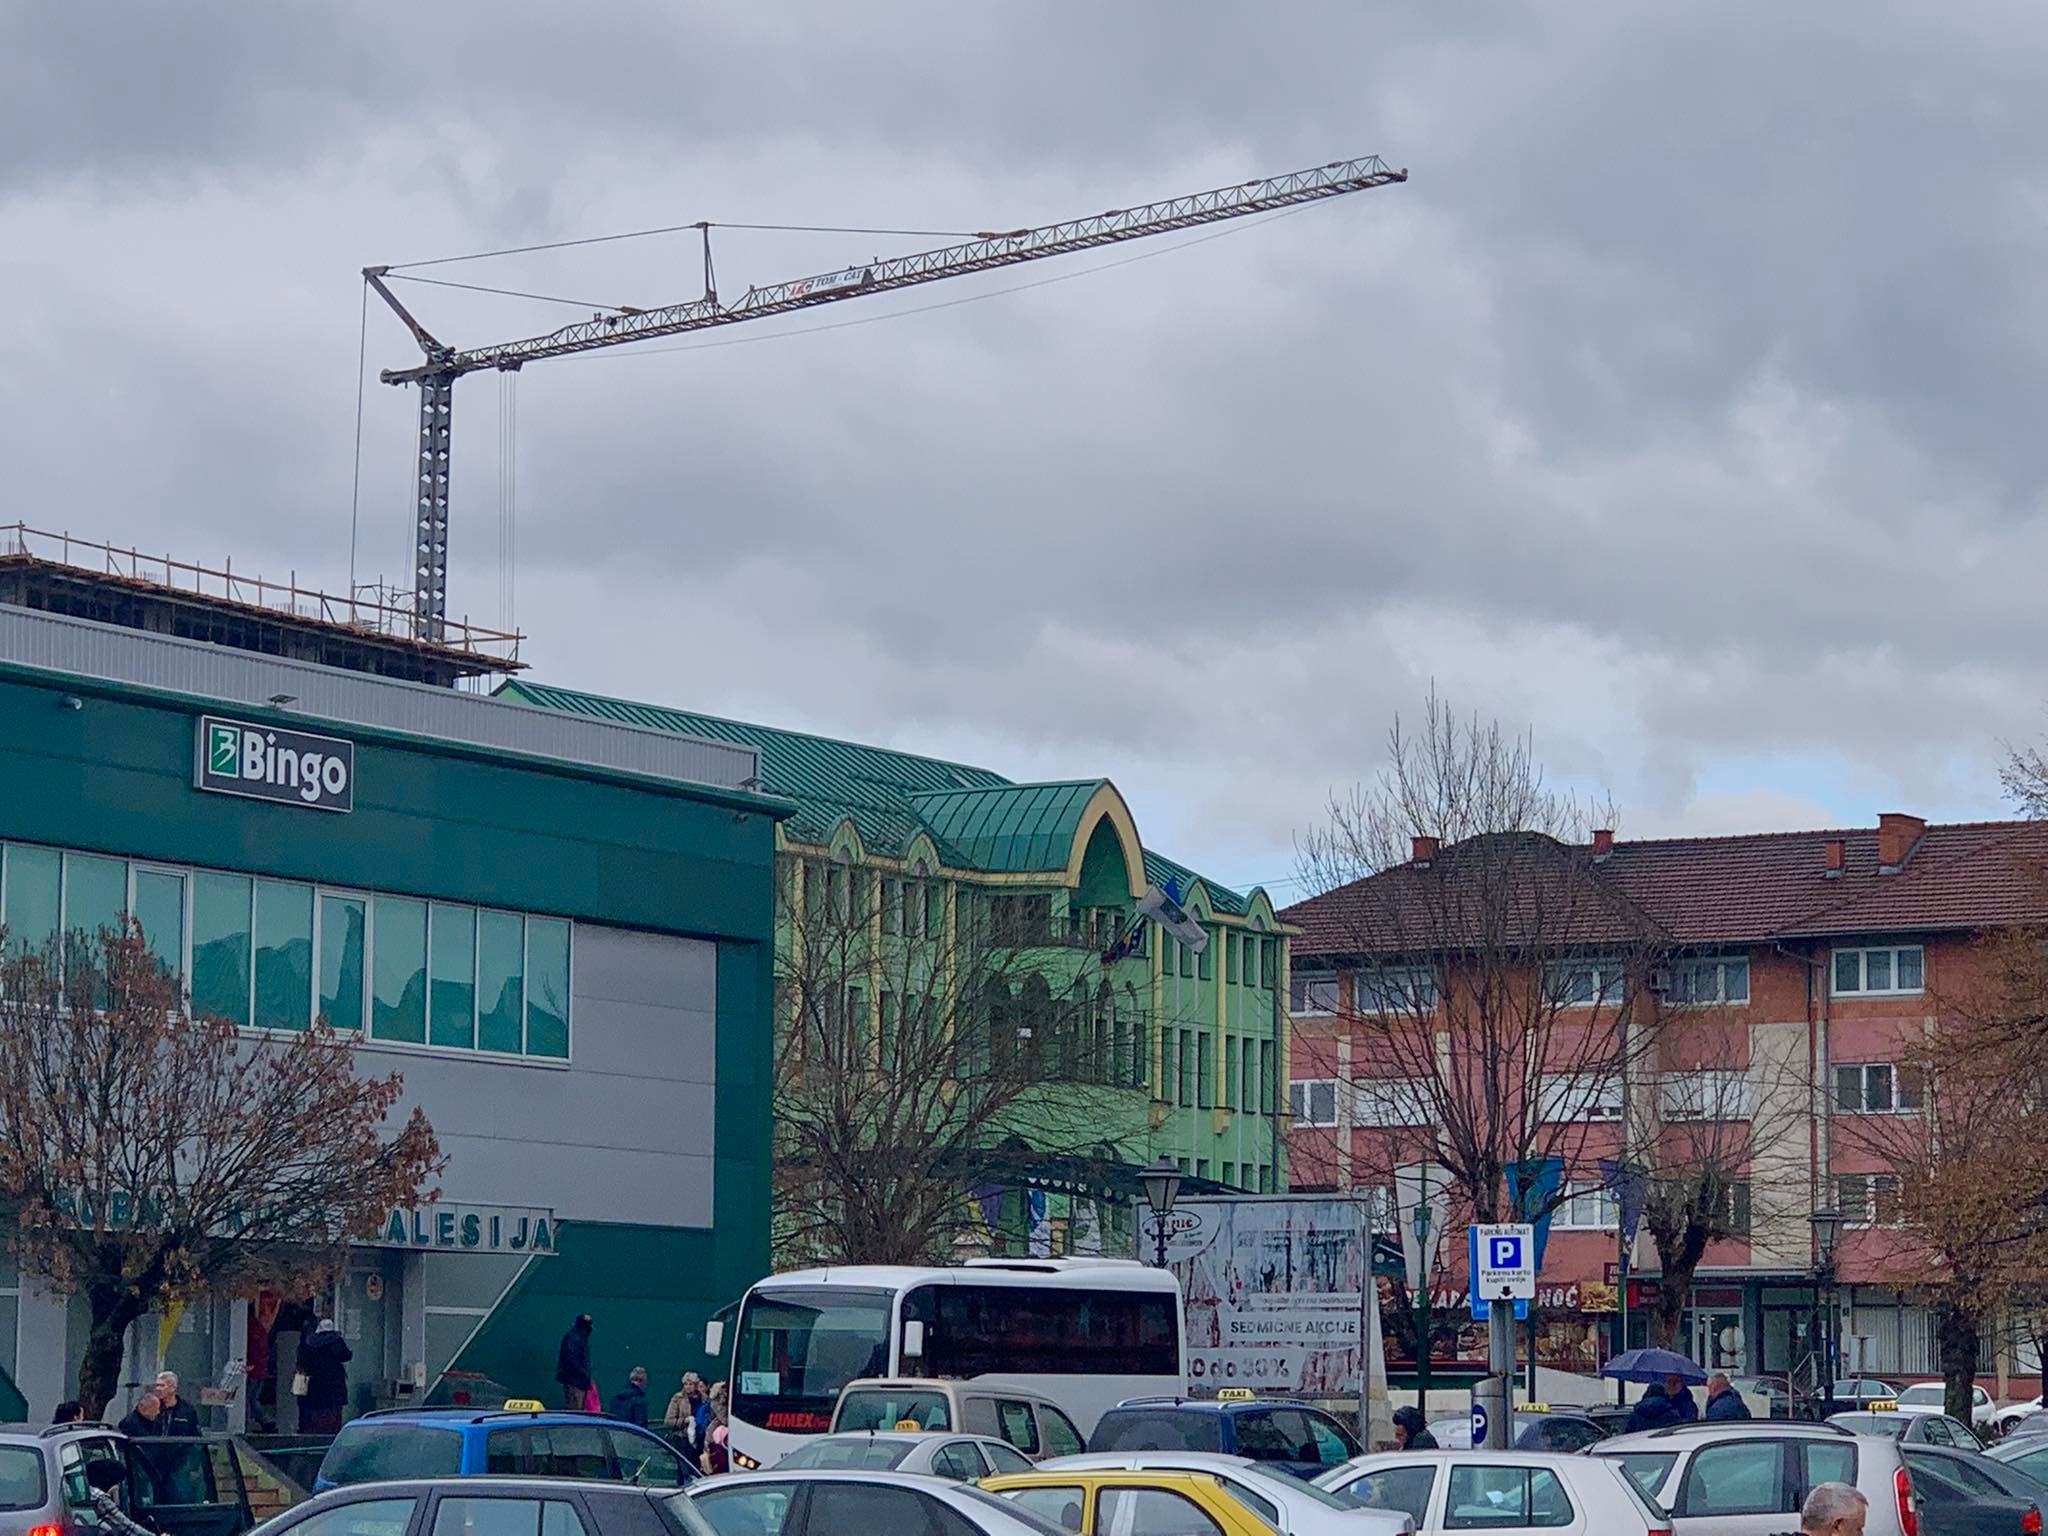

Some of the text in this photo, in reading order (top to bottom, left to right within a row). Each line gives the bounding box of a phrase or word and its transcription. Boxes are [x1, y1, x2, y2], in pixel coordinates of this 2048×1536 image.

[844, 270, 863, 281] CAT
[242, 731, 347, 802] Bingo
[376, 1209, 554, 1251] ALESIJA
[1497, 1241, 1514, 1265] P
[1305, 1320, 1356, 1334] AKCIJE
[1210, 1358, 1237, 1378] do
[1222, 1390, 1247, 1398] TAXI
[766, 1412, 815, 1428] JUMEX
[897, 1422, 914, 1431] TAXI
[1472, 1414, 1486, 1435] P
